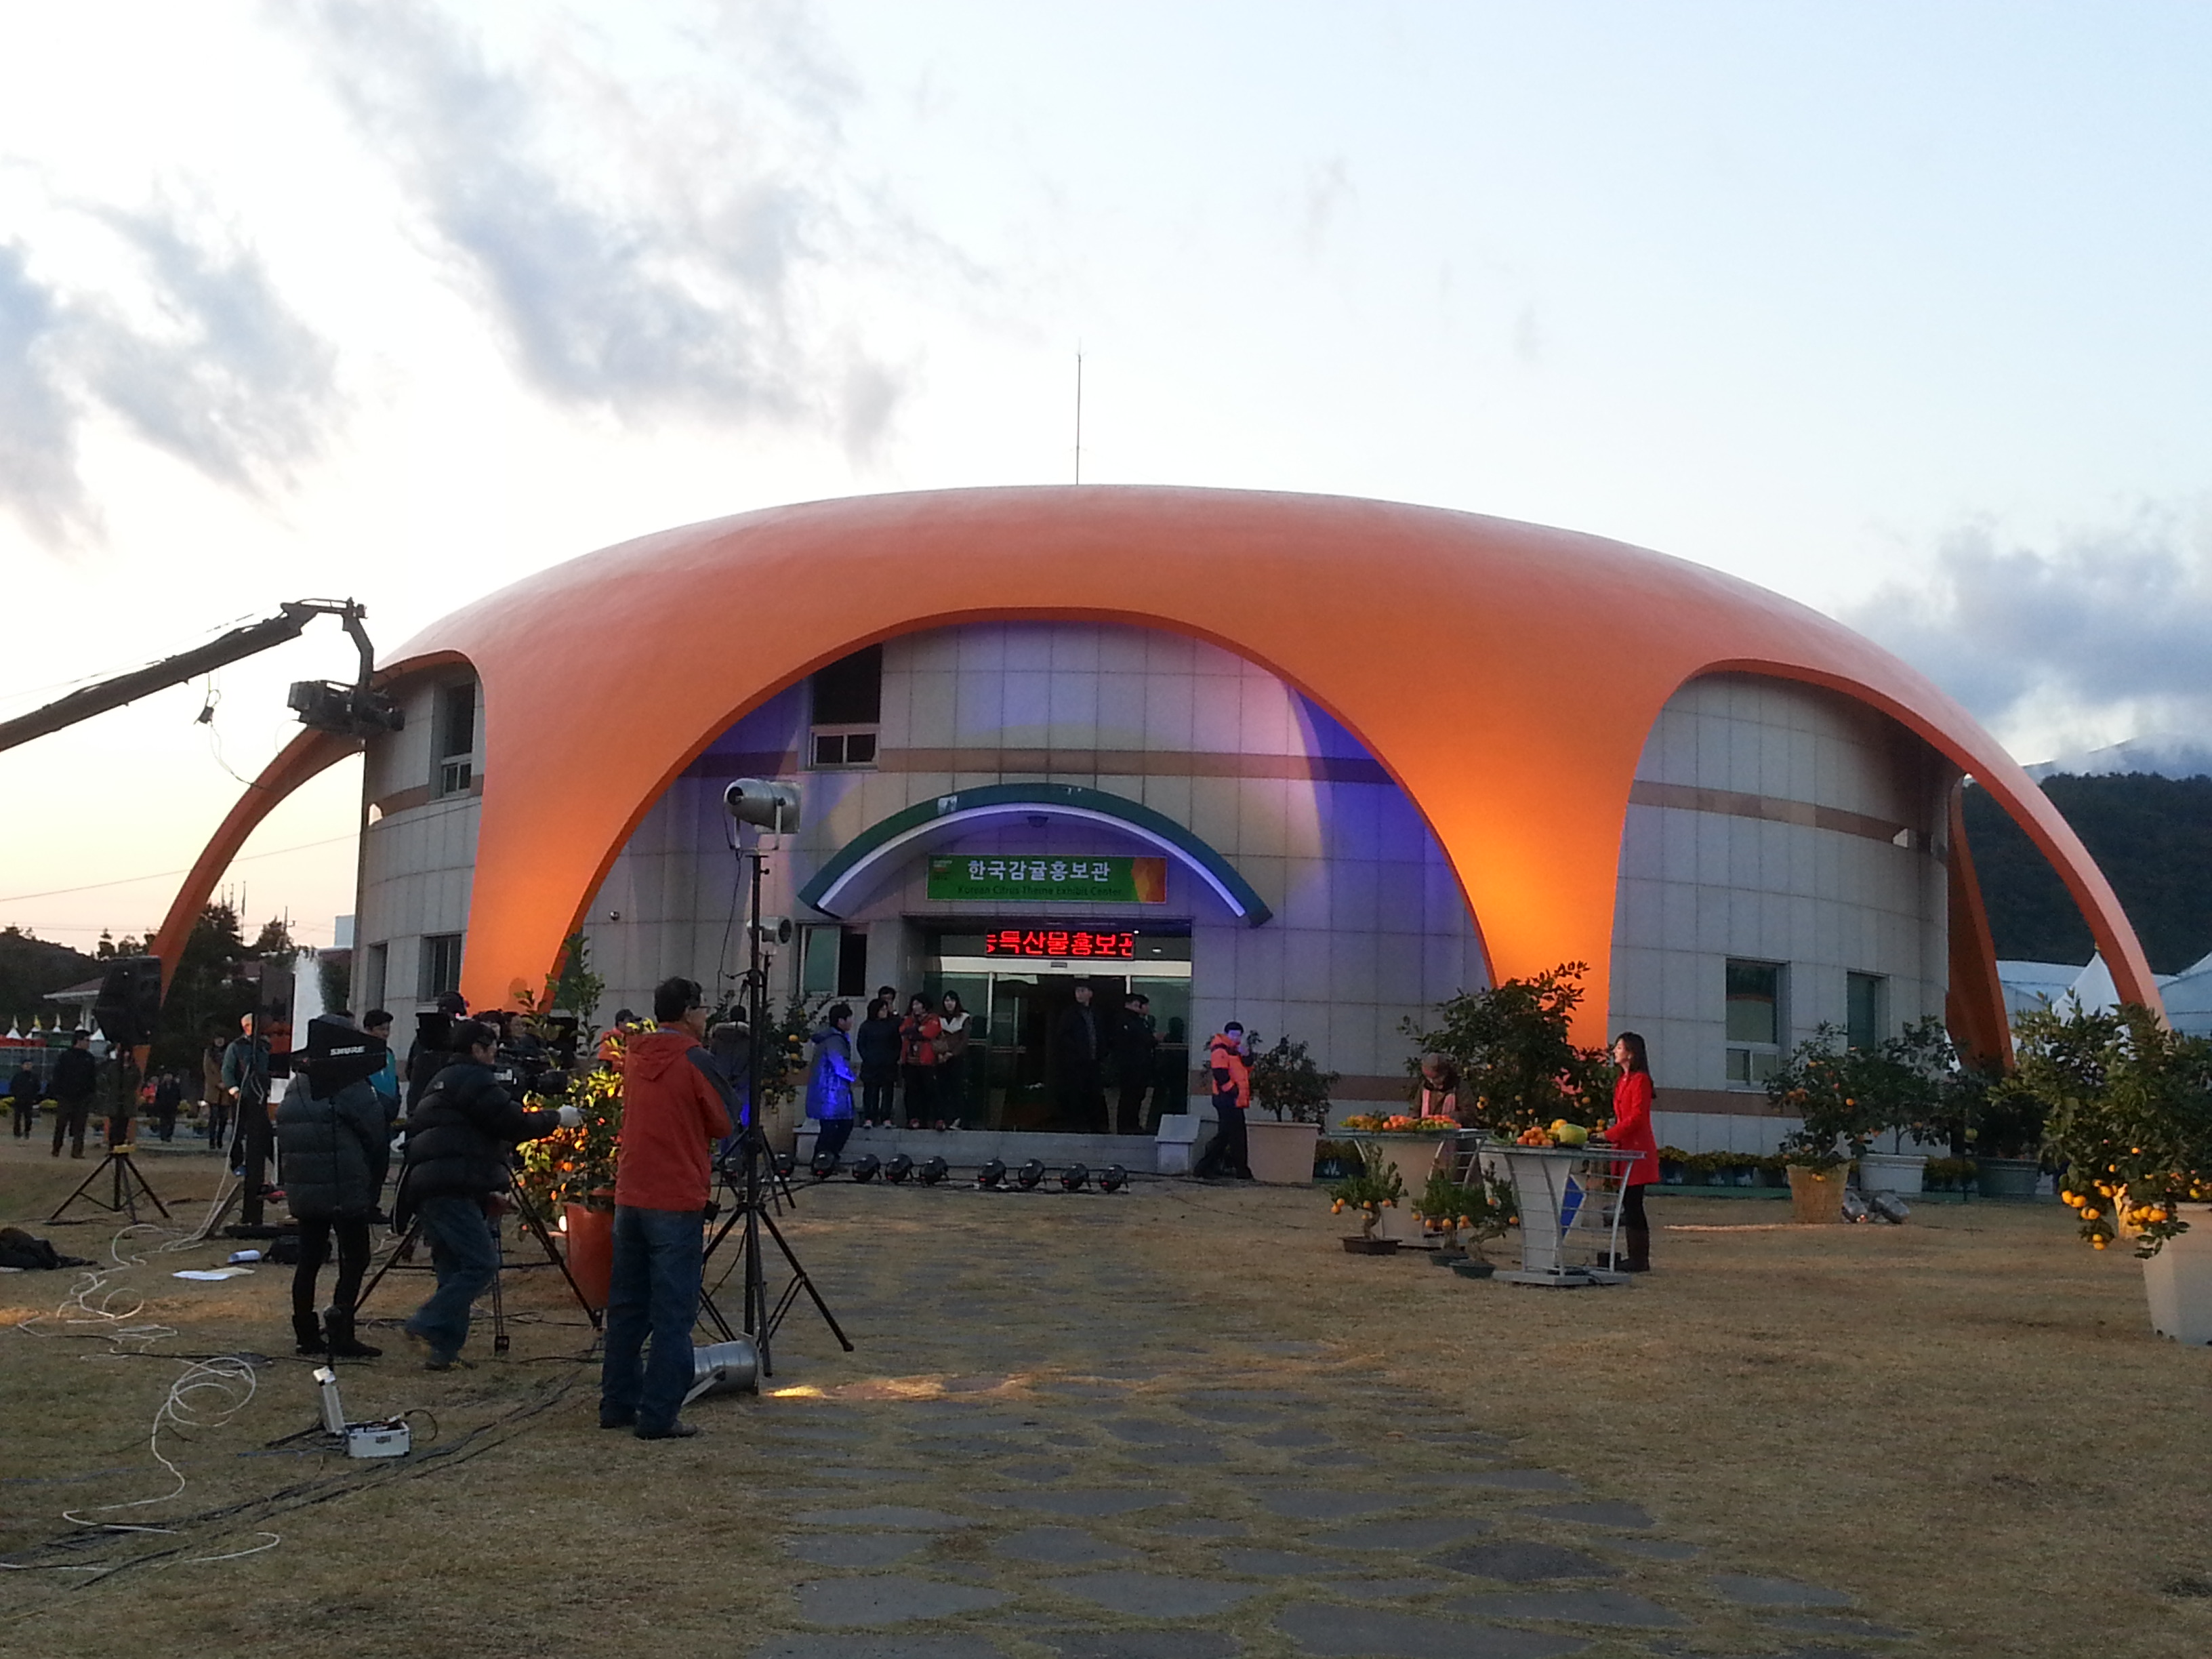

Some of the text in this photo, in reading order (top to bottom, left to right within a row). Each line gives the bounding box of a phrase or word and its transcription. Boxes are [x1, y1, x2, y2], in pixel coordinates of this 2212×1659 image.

[968, 860, 1111, 882] 한국감귤홍보관
[958, 885, 1122, 896] Korean Citrus Theme Exhibit Center
[330, 1045, 366, 1056] SHURE
